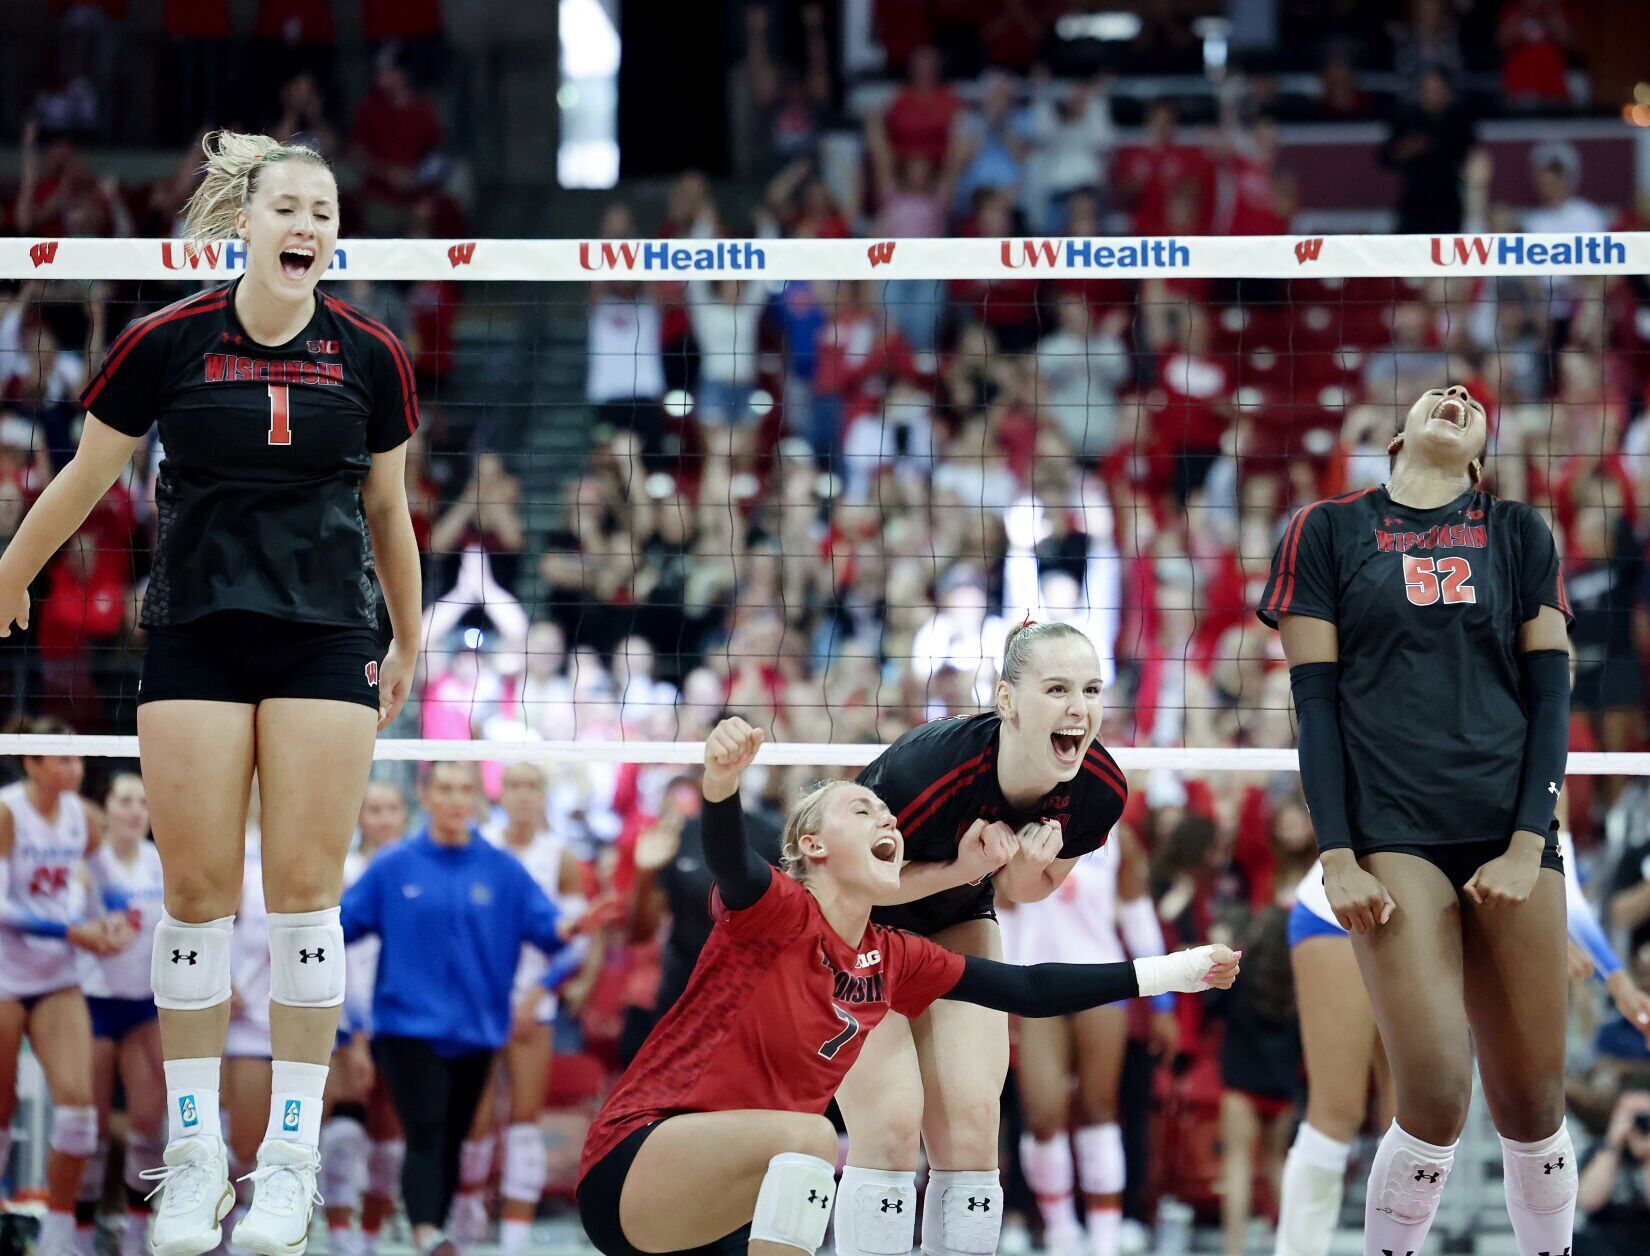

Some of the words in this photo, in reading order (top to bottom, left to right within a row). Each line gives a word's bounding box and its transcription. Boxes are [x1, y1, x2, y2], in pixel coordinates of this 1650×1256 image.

[204, 352, 344, 387] WISCONSIN
[267, 383, 292, 445] 1
[1402, 553, 1477, 606] 52
[817, 1002, 860, 1061] 7
